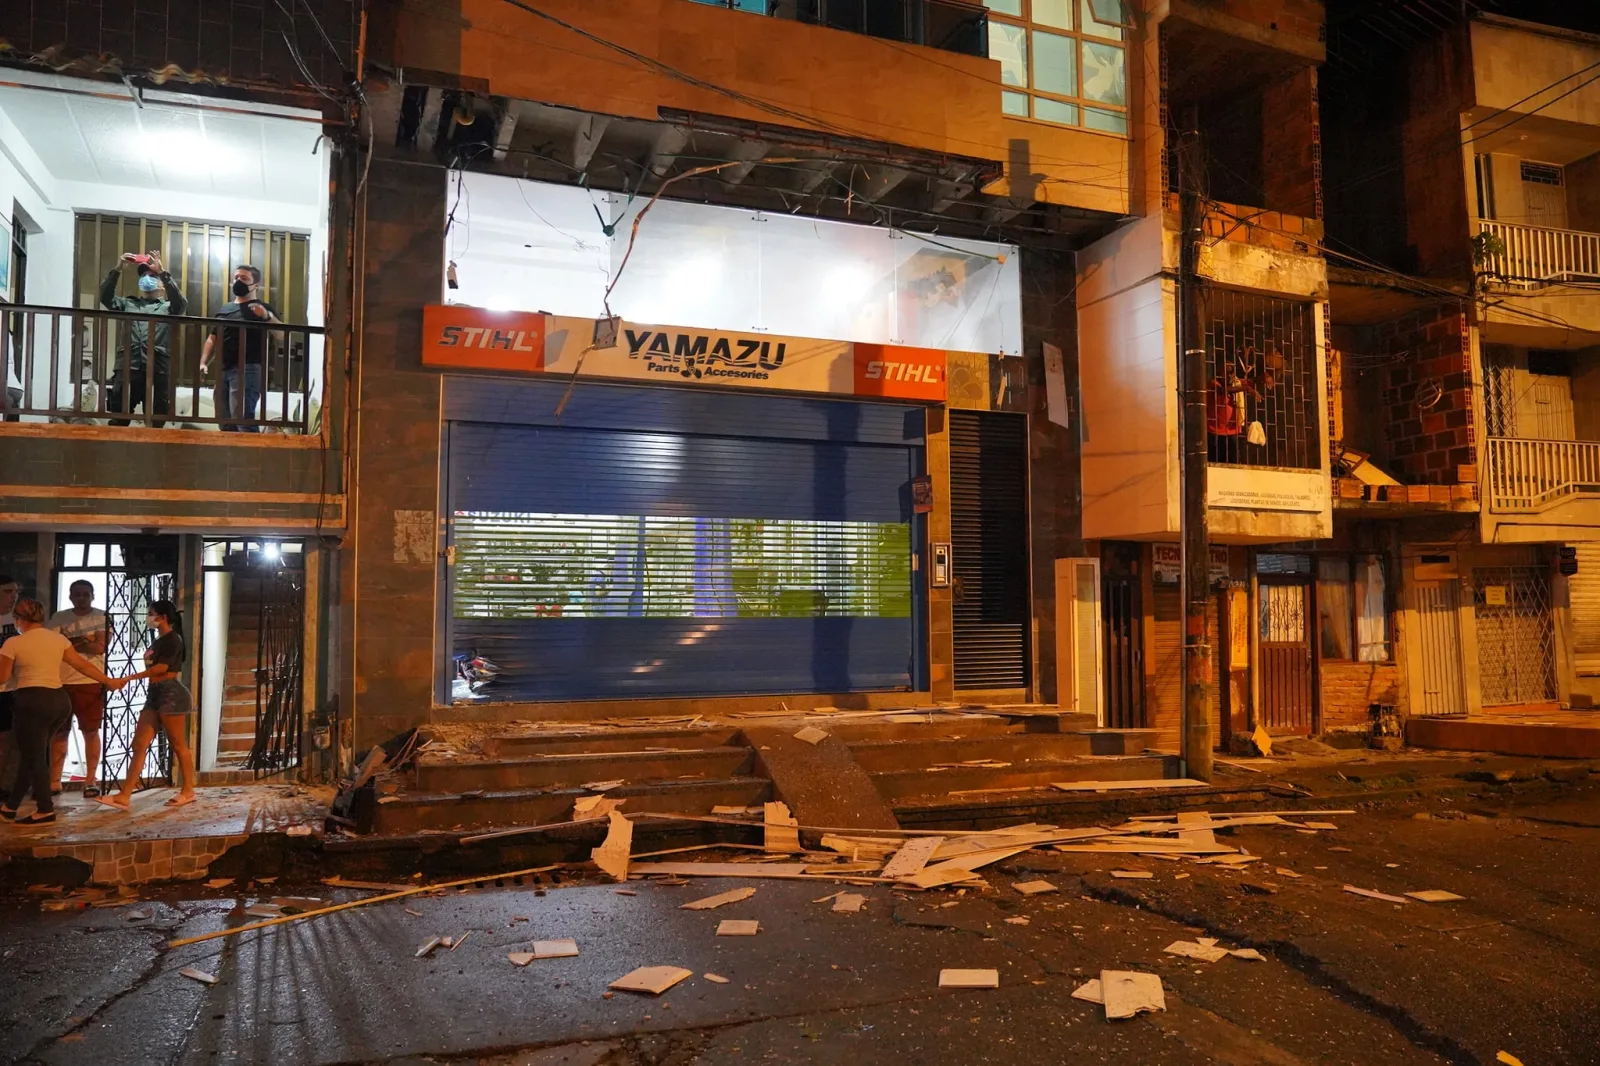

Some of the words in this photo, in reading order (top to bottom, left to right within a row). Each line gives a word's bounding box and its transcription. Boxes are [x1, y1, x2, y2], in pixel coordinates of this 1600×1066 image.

[438, 326, 533, 352] STIHL
[624, 329, 786, 371] YAMAZU
[647, 362, 680, 373] Parts
[704, 366, 769, 380] Accesories
[865, 361, 938, 384] STIHL
